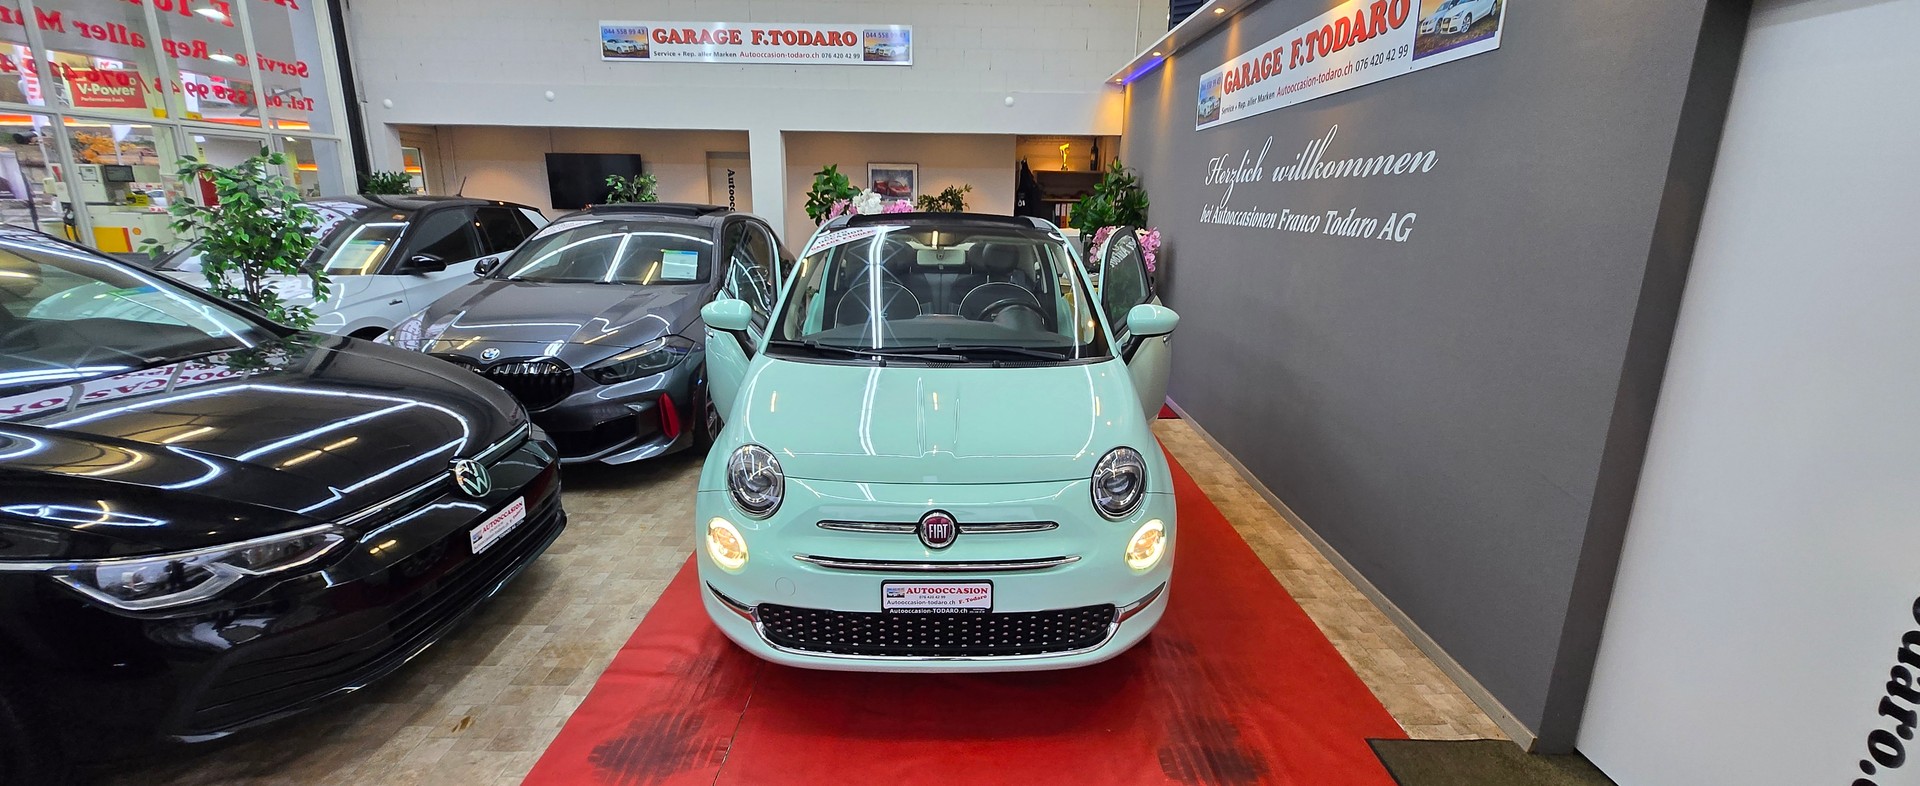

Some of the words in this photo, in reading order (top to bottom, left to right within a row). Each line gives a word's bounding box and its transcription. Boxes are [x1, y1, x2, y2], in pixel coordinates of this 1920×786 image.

[652, 28, 743, 45] GARAGE
[750, 29, 858, 47] F.TODARO
[1223, 46, 1284, 95] GARAGE
[1289, 0, 1411, 70] F.TODARO
[739, 51, 820, 59] Autooccasion-todaro.ch
[1257, 91, 1276, 102] Marken
[1276, 61, 1353, 98] Autooccasion-todaro.ch
[1355, 58, 1368, 72] 076
[1370, 52, 1384, 67] 420
[1385, 48, 1396, 64] 42
[1398, 44, 1409, 59] 99
[76, 82, 136, 96] V-Power
[1205, 135, 1273, 209] Herzlich
[1272, 124, 1439, 182] willkommen
[1200, 203, 1214, 223] bei
[1277, 208, 1321, 233] Franco
[1322, 207, 1378, 239] Todaro
[1377, 212, 1417, 243] AG
[928, 523, 949, 539] FIAT
